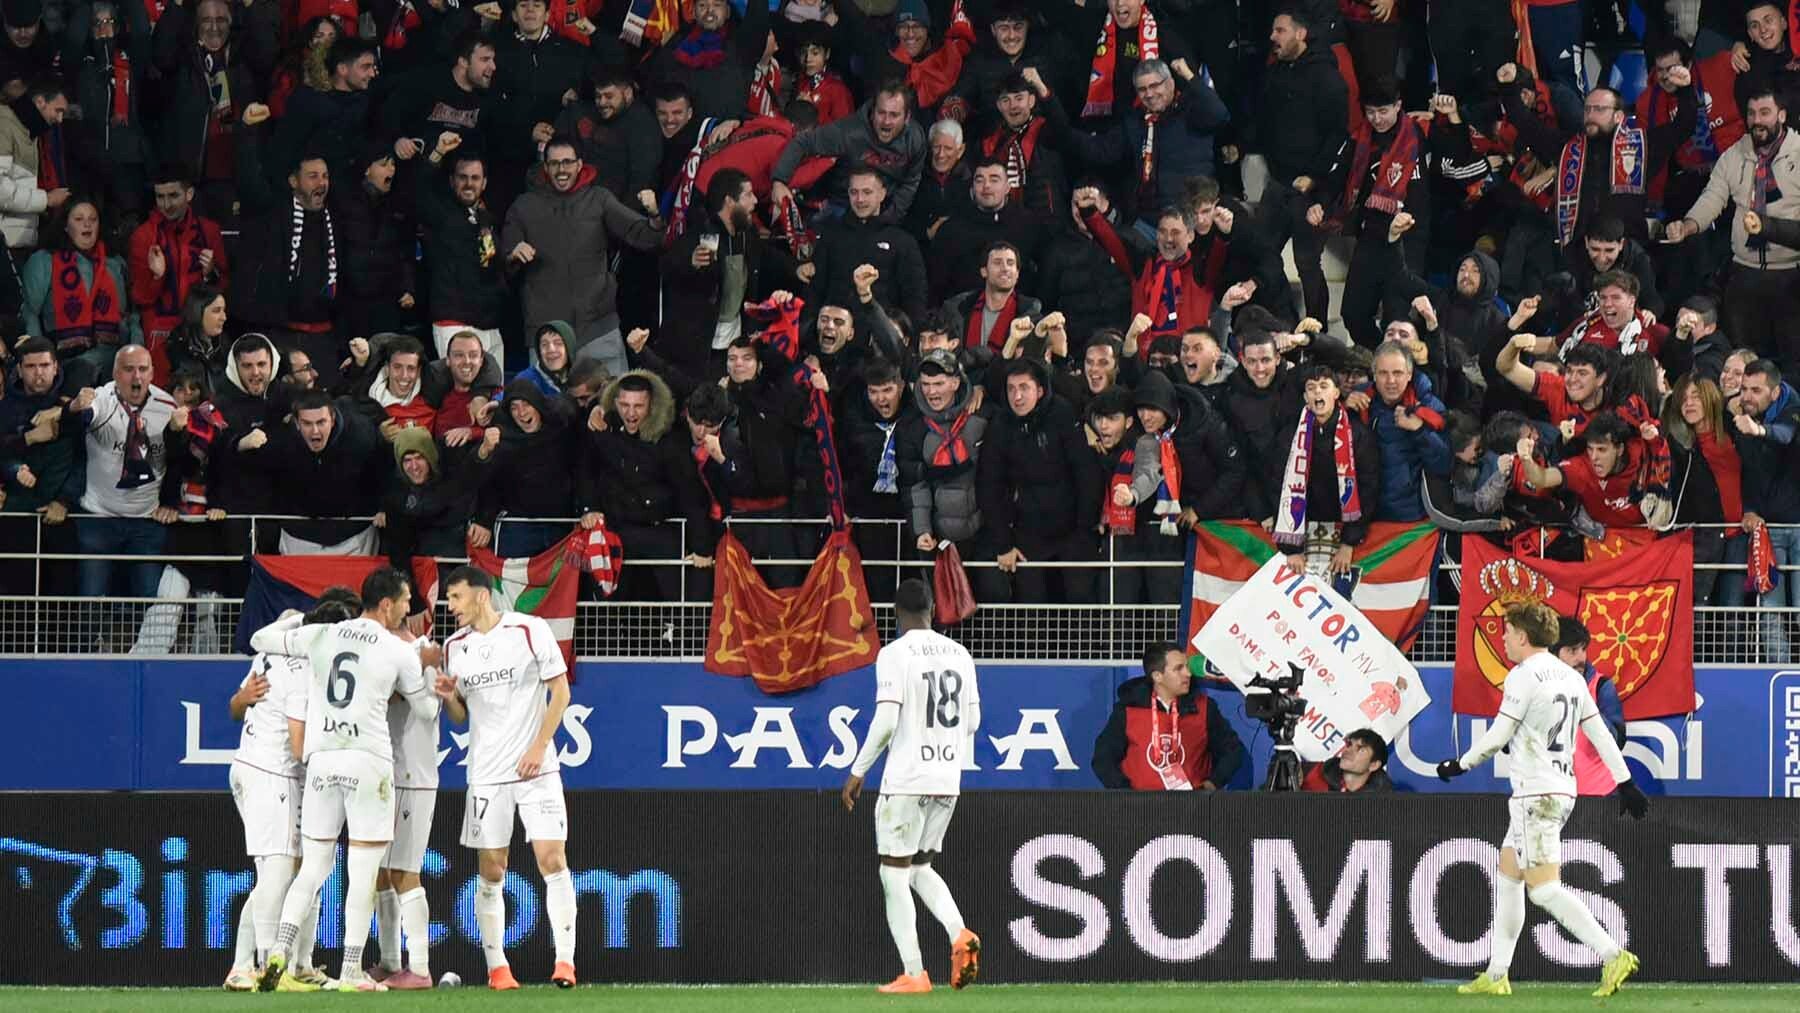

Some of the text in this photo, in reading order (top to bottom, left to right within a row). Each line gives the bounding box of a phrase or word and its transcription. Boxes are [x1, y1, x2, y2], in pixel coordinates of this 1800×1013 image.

[1266, 610, 1297, 647] POR
[1273, 564, 1360, 653] VICTOR
[1229, 623, 1267, 661] DAME
[326, 651, 360, 709] 6
[922, 669, 962, 728] 18
[1547, 693, 1579, 751] 21
[921, 745, 958, 762] DIG
[472, 796, 490, 820] 17
[1008, 833, 1631, 968] SOMOS
